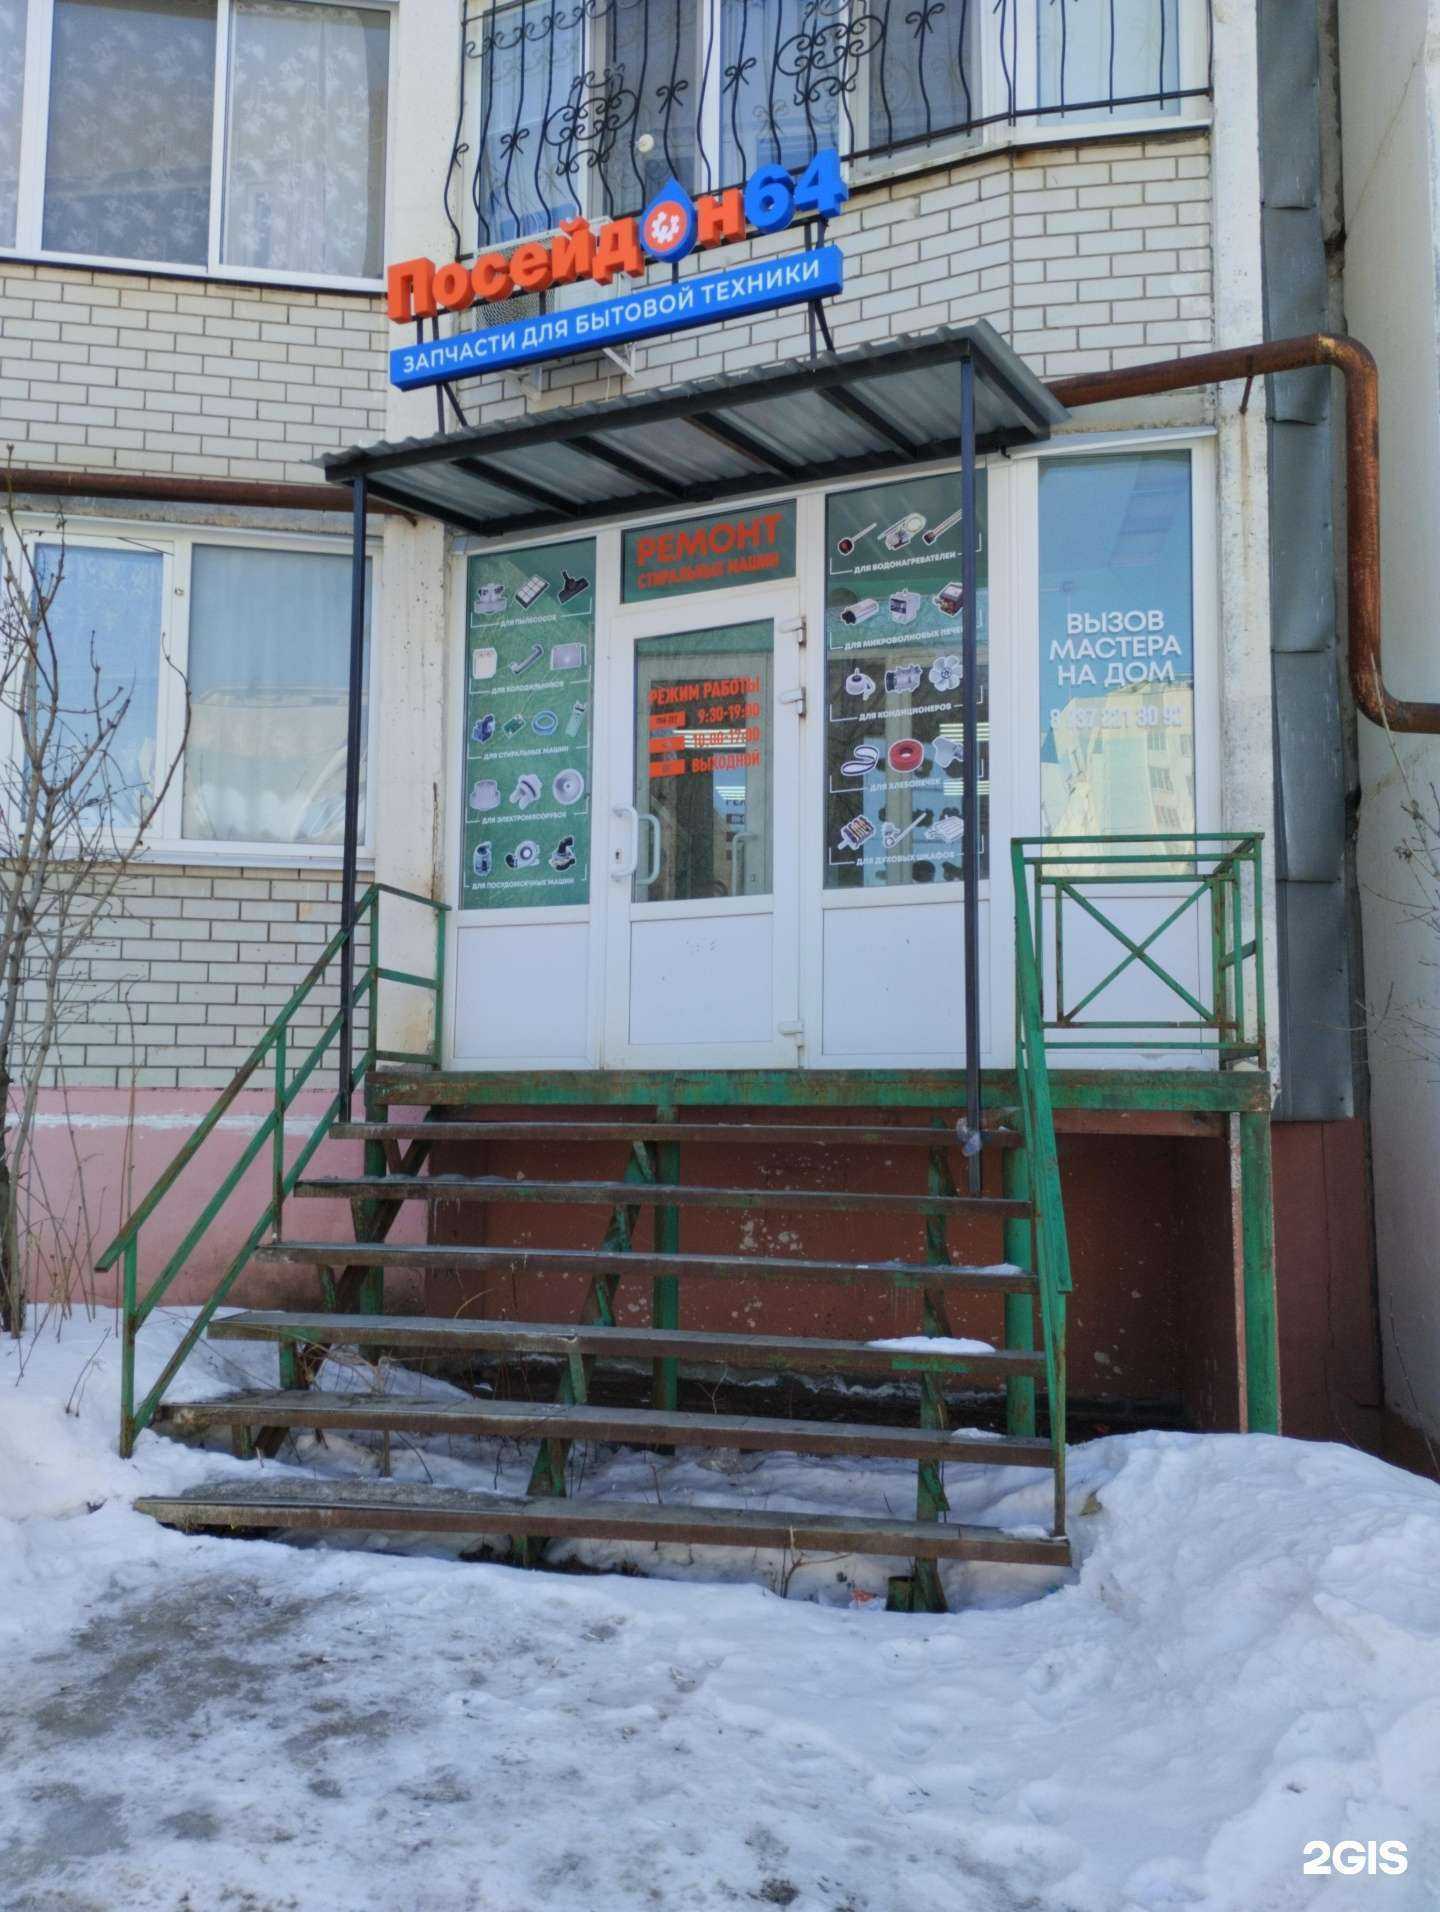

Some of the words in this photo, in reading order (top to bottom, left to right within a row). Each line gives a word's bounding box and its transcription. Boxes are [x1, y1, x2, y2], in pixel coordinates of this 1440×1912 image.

[403, 331, 516, 373] ЗАПЧАСТИ
[522, 320, 569, 349] ДЛЯ
[576, 285, 693, 334] БЫТОВОЙ
[701, 259, 819, 304] ТЕХНИКИ
[636, 512, 783, 567] РЕМОНТ
[854, 563, 871, 574] ДЛЯ
[1067, 609, 1165, 635] ВЫЗОВ
[845, 640, 861, 650] ДЛЯ
[1049, 634, 1182, 661] МАСТЕРА
[1057, 663, 1097, 688] НА
[1103, 659, 1176, 688] ДОМ
[648, 684, 699, 704] РЕЖИМ
[703, 672, 760, 698] РАБОТЫ
[859, 713, 876, 721] ДЛЯ
[877, 703, 952, 719] КОНДИЦИОНЕРОВ
[1050, 708, 1061, 730] 8
[692, 749, 760, 773] ВЫХОДНОЙ
